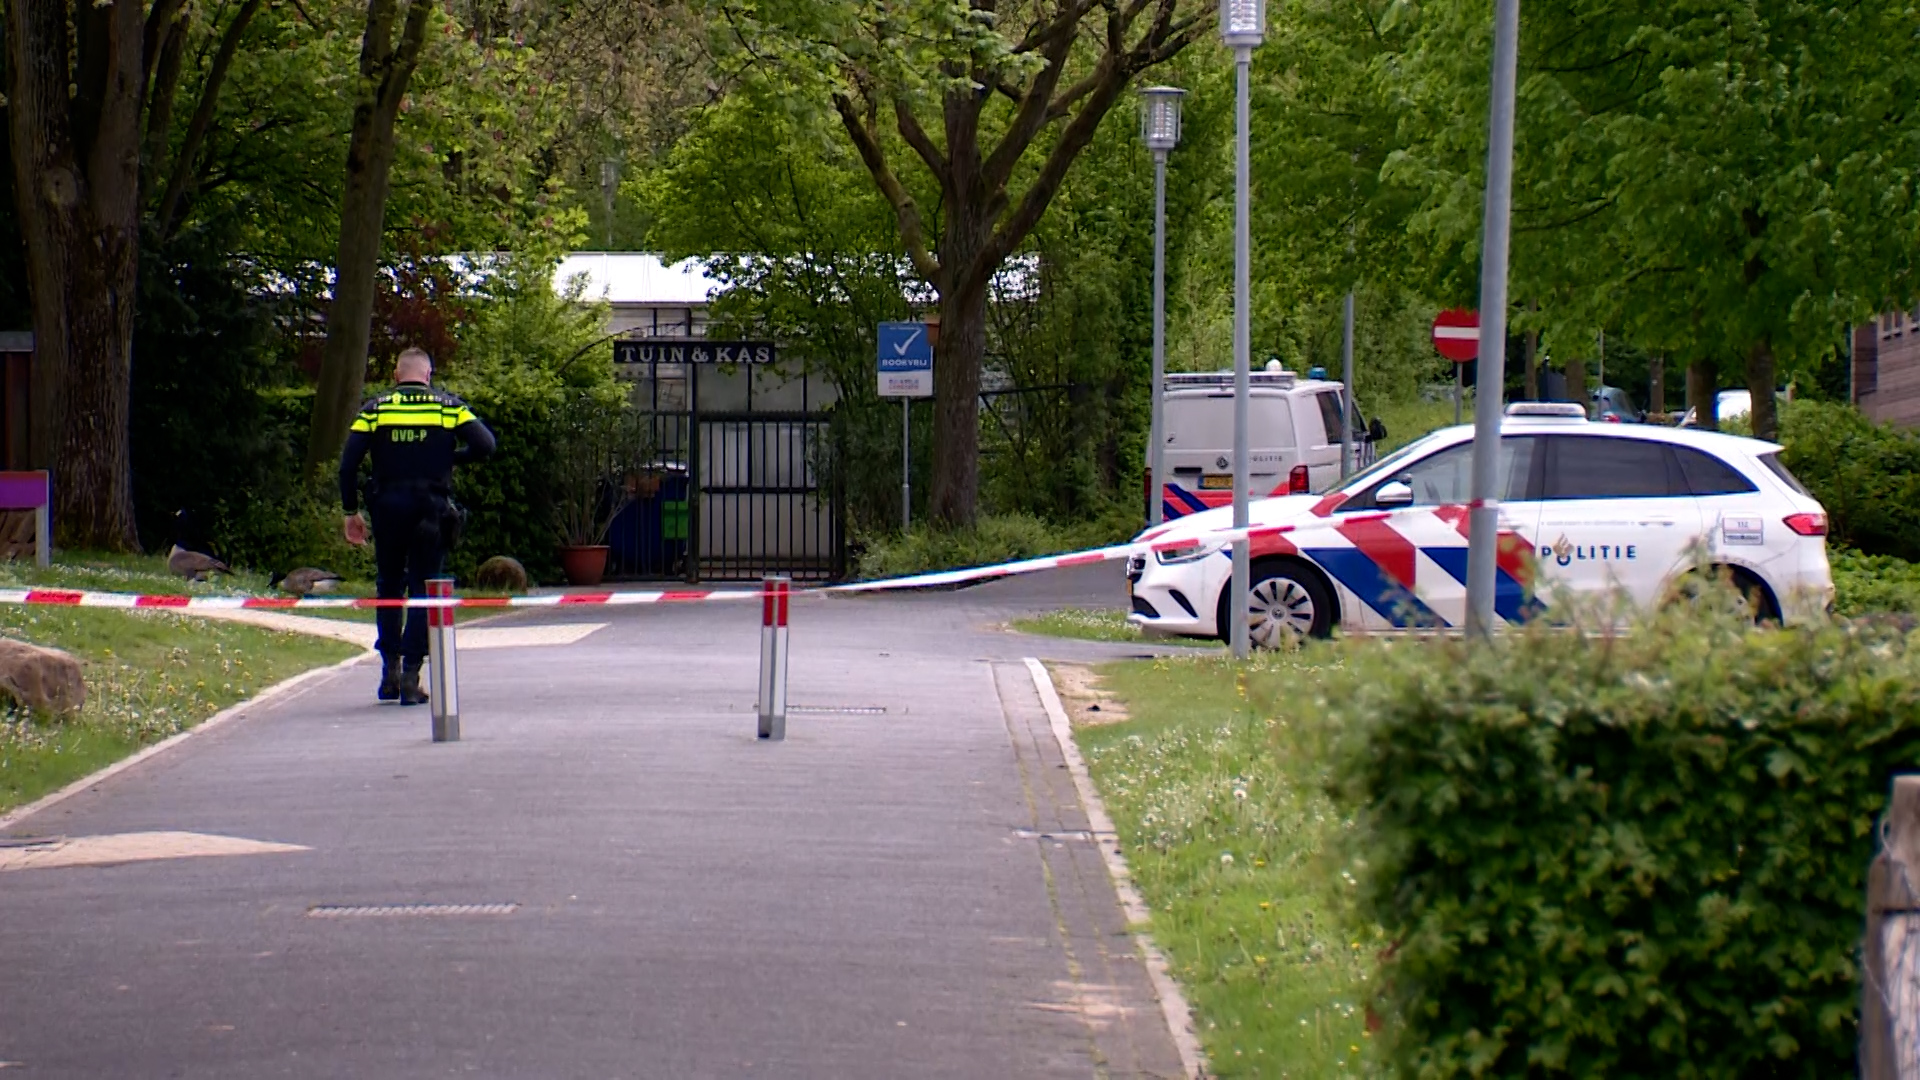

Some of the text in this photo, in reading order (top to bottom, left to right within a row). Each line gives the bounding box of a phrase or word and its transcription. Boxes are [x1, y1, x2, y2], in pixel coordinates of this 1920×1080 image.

[621, 347, 770, 363] TUIN & KAS
[1541, 544, 1637, 567] POLITIE
